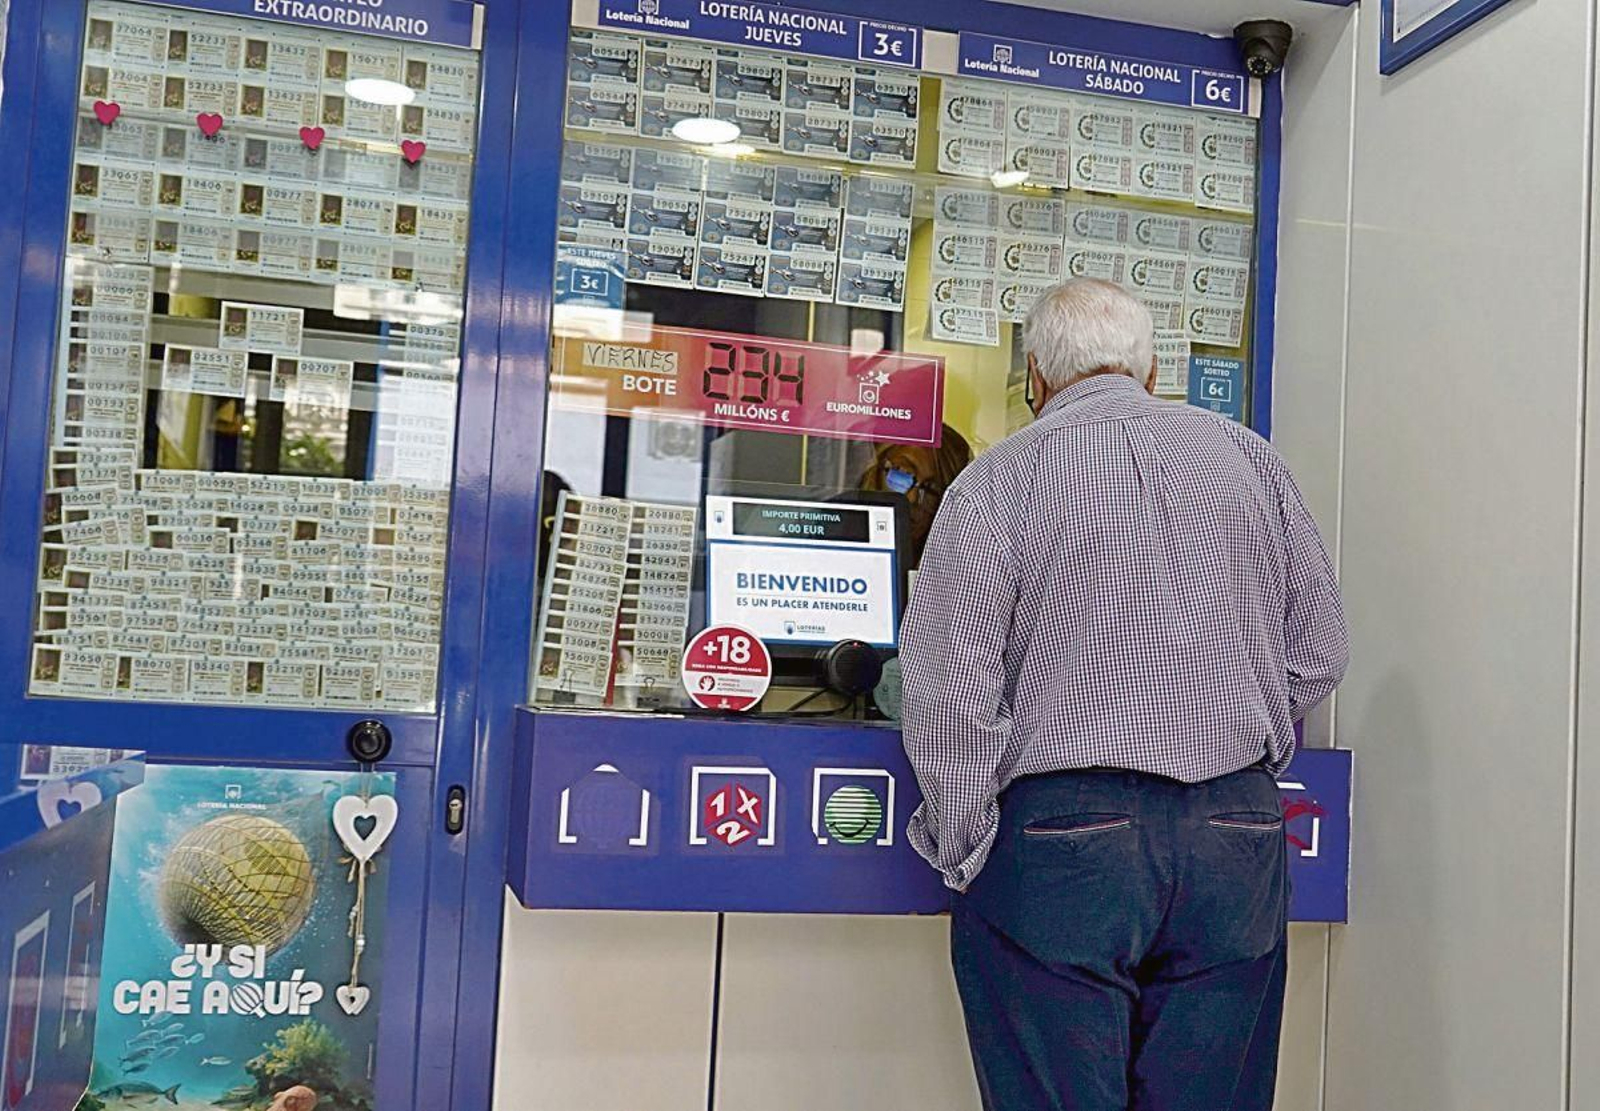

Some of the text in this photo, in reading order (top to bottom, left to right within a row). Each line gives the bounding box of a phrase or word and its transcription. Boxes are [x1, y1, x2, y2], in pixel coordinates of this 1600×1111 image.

[254, 0, 428, 36] EXTRAORDINARIO
[606, 9, 689, 30] Lotería Nacional
[700, 1, 847, 35] LOTERÍA NACIONAL
[744, 25, 802, 47] JUEVES
[964, 58, 1040, 78] Lotería Nacional
[1049, 50, 1180, 83] LOTERÍA NACIONAL
[1085, 71, 1144, 94] SÁBADO
[587, 343, 675, 373] VIERNES
[1196, 358, 1211, 367] ESTE
[703, 342, 804, 405] 234
[1204, 368, 1230, 376] SORTEO
[623, 374, 676, 396] BOTE
[714, 400, 778, 421] MILLÓNS
[826, 402, 912, 420] EUROMILLONES
[762, 510, 841, 522] IMPORTE PRIMITIVA
[802, 525, 824, 536] EUR
[736, 572, 868, 595] BIENVENIDO
[736, 597, 868, 612] ES UN PLACER ATENDERLE
[703, 635, 750, 664] +18
[171, 944, 266, 979] ¿Y SI
[113, 968, 324, 1019] CAE AQUÍ?
